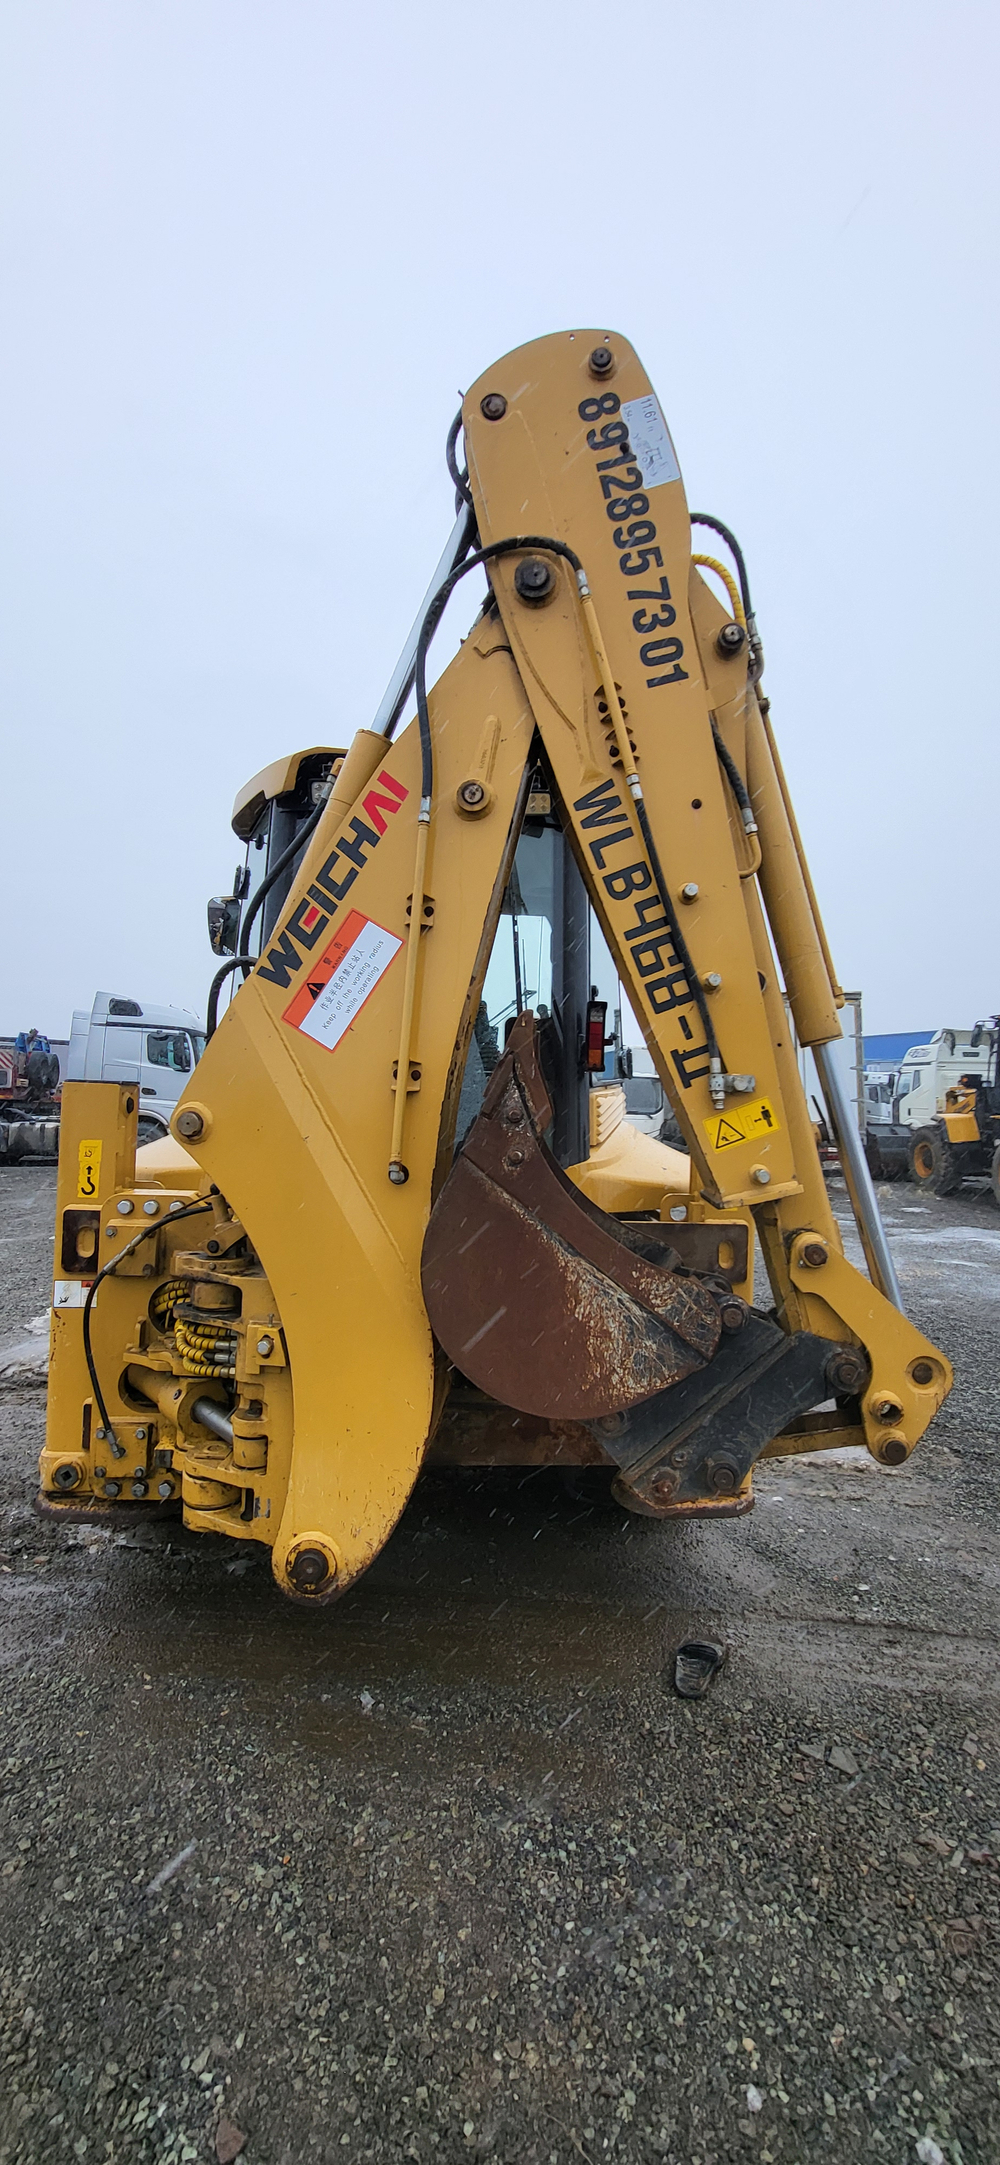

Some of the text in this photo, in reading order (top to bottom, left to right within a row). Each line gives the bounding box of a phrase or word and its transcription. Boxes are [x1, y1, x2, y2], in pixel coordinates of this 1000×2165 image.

[640, 398, 658, 424] 11.61
[256, 770, 410, 989] WEICHAI
[320, 949, 365, 1011] 作业半径内禁止站人
[321, 940, 384, 1030] Keep off the working radius
[331, 946, 349, 969] WARNING
[345, 966, 380, 1014] while operating
